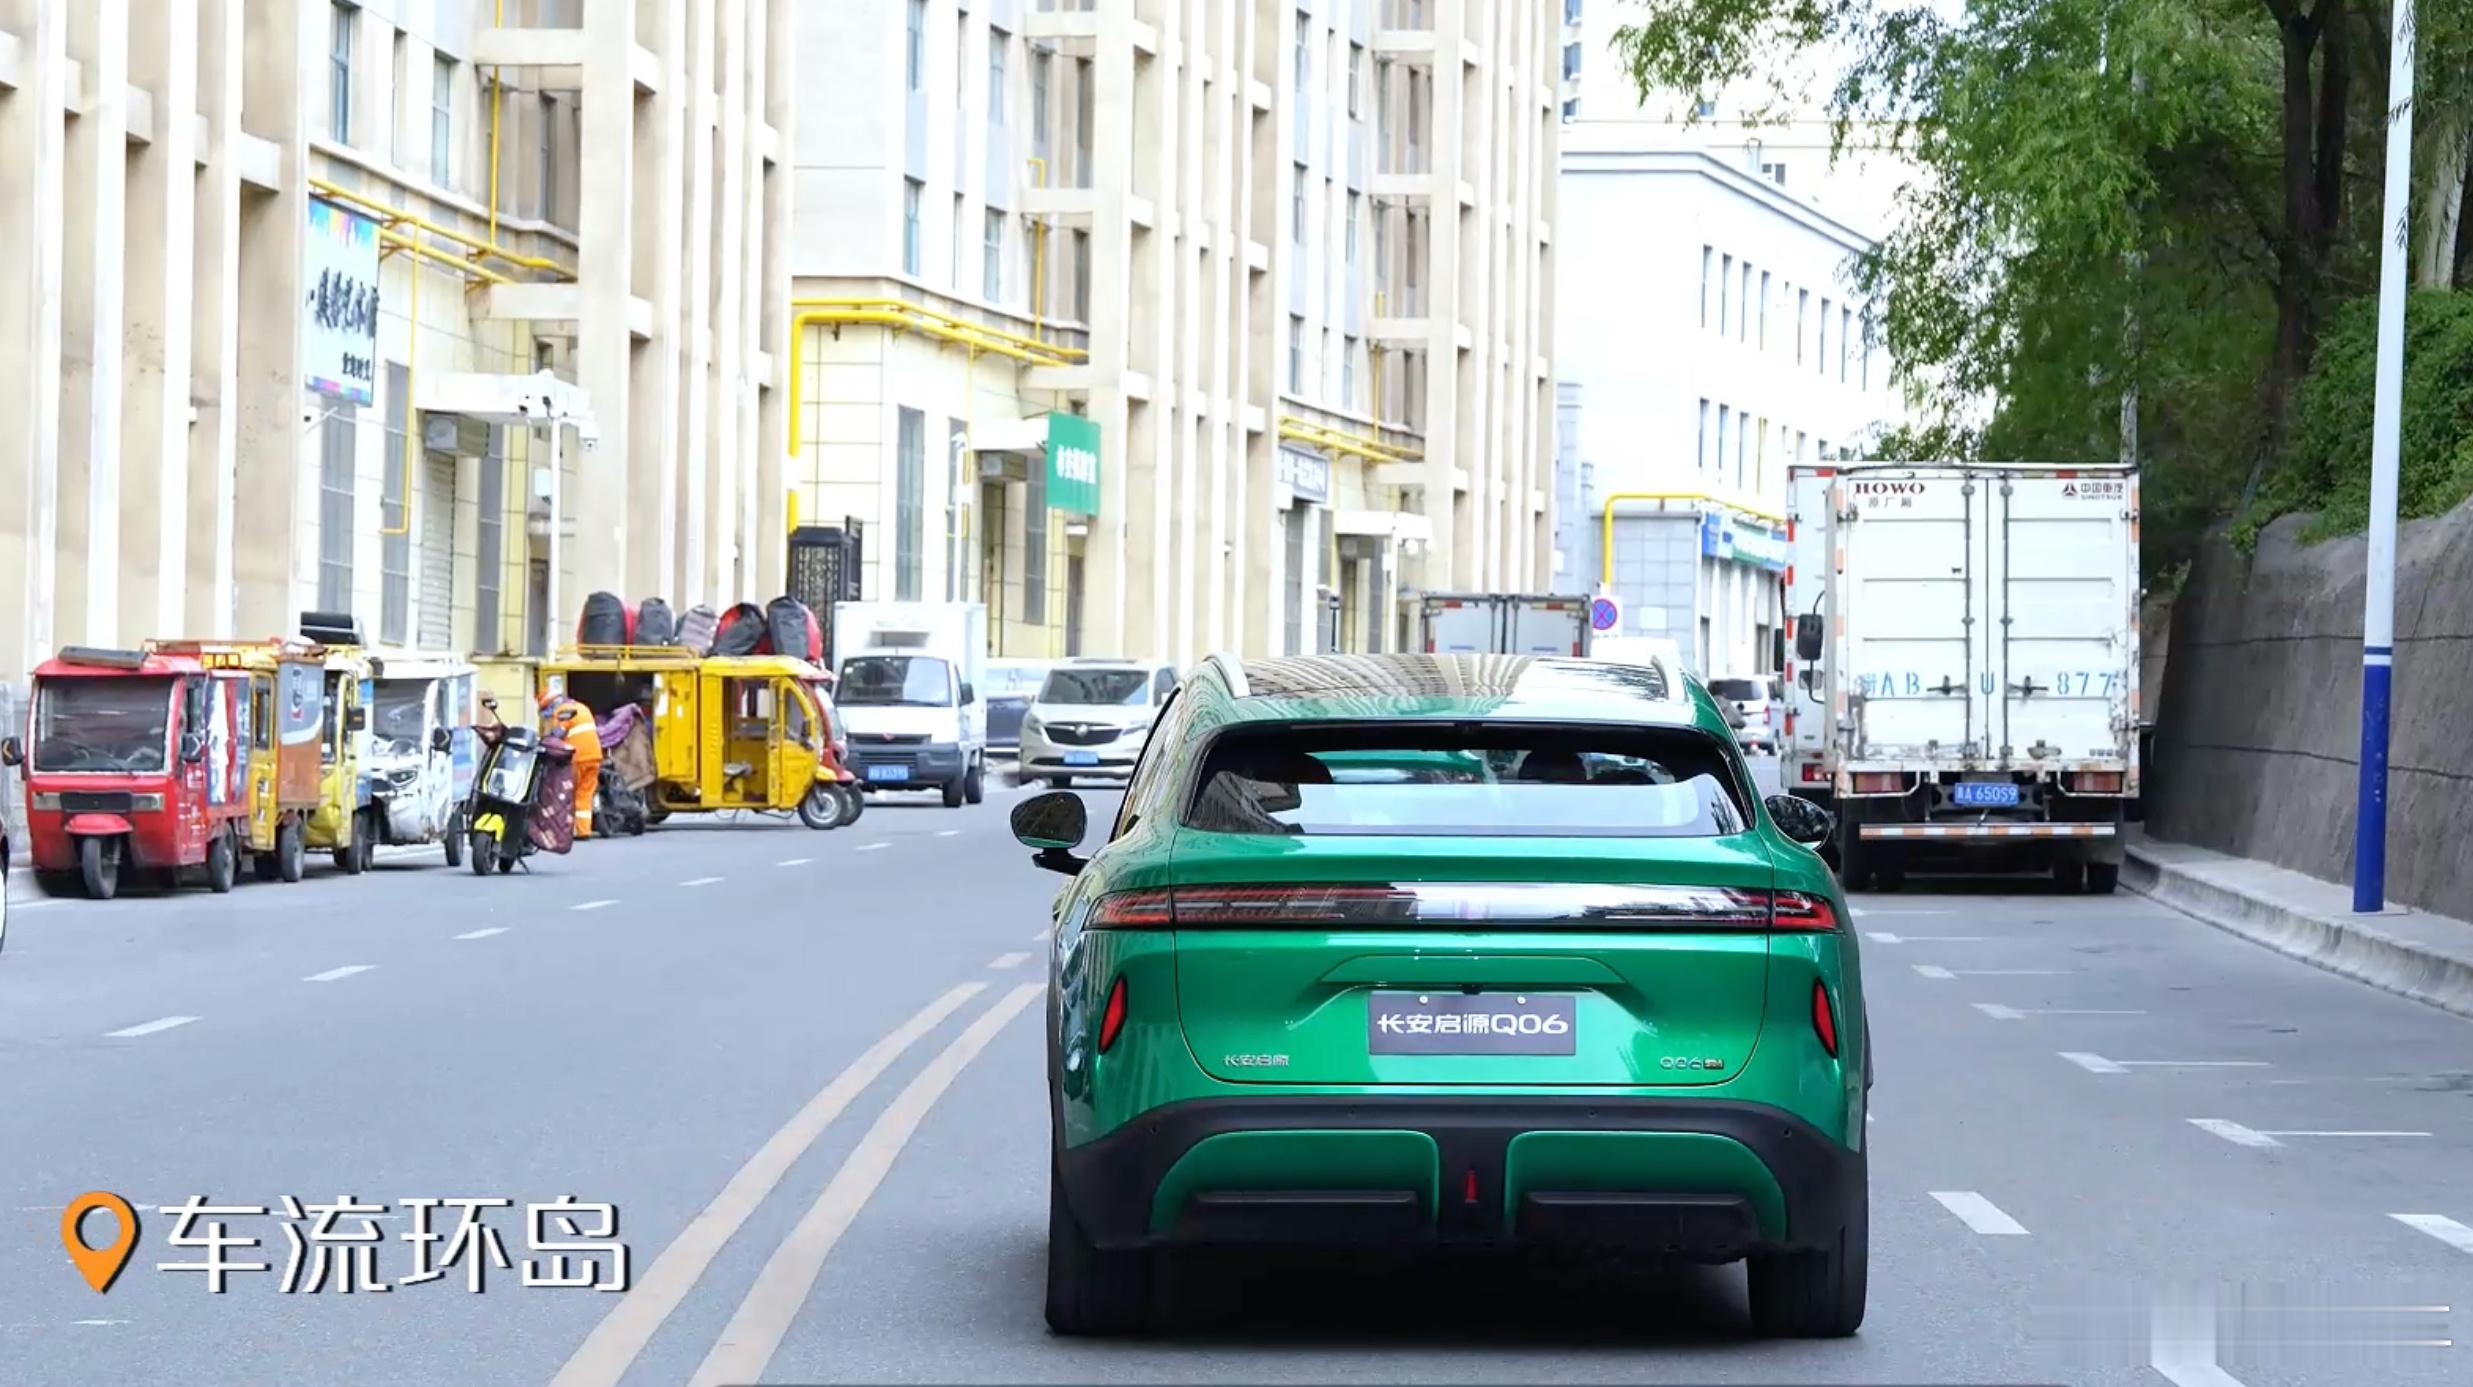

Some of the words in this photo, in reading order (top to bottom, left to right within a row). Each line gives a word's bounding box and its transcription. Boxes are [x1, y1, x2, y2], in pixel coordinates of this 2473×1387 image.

[1855, 483, 1925, 494] HOWO
[1377, 1013, 1569, 1036] 长安启源Q06
